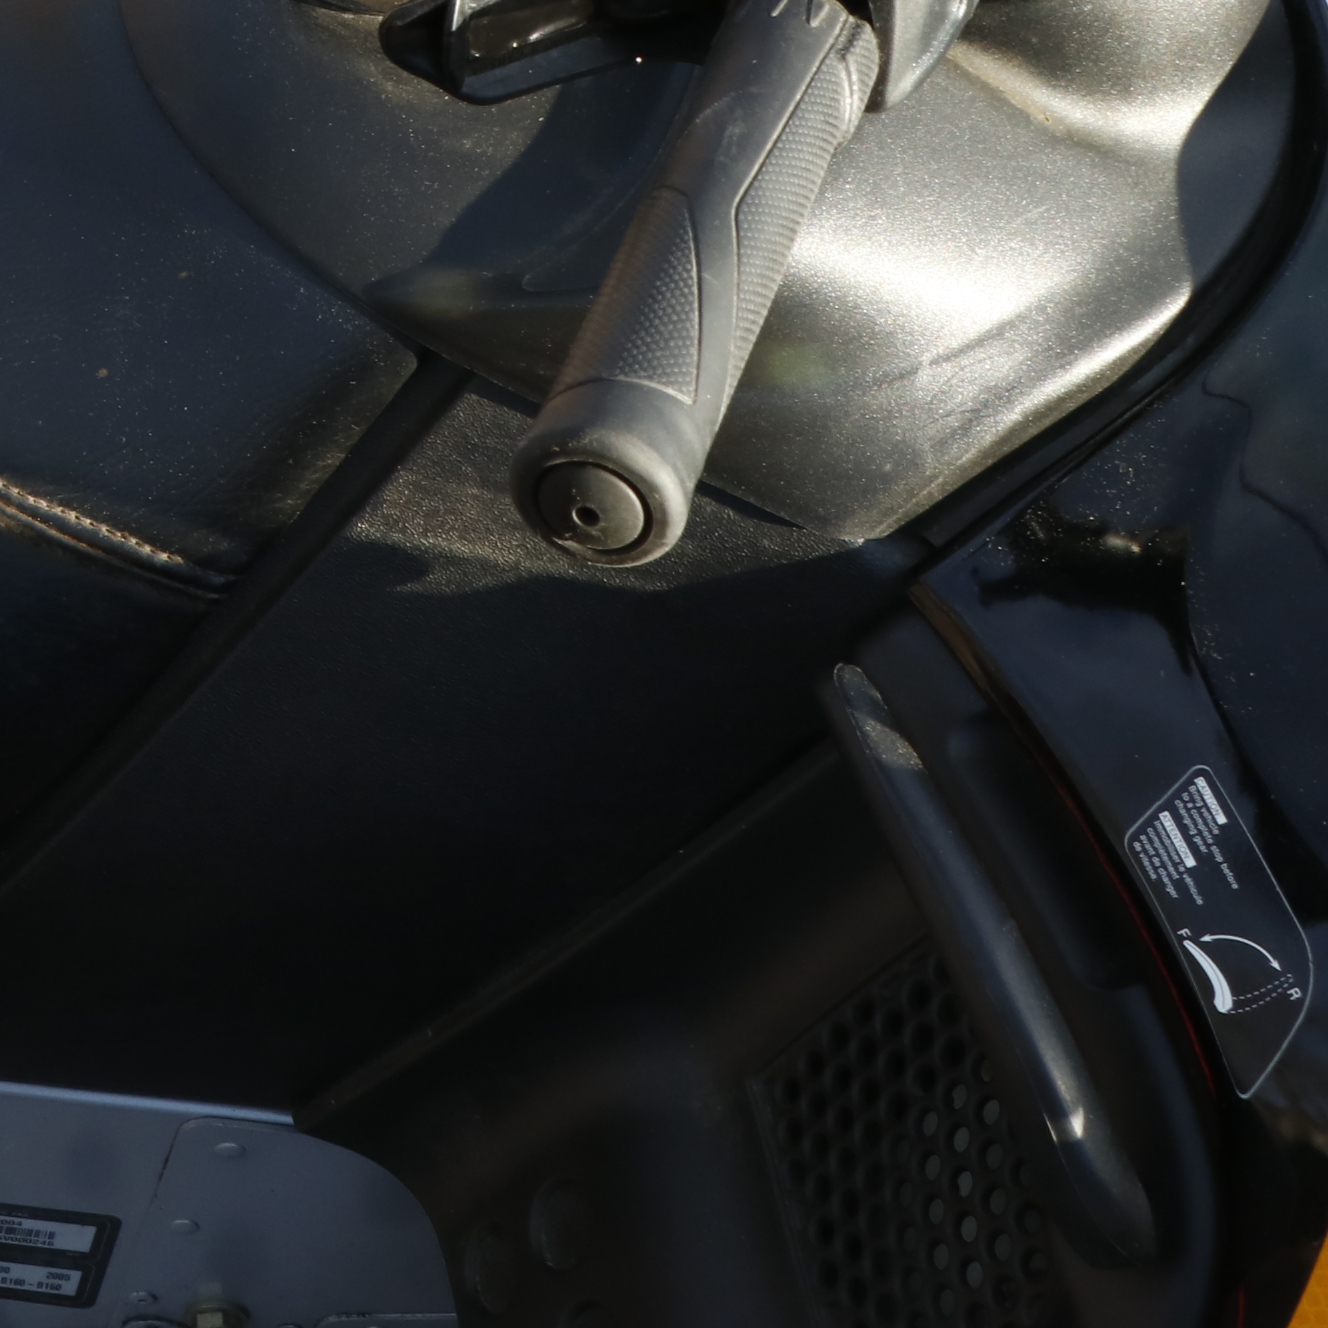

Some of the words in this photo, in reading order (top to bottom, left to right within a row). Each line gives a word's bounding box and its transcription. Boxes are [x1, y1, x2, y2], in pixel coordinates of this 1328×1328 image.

[1174, 799, 1198, 835] changing
[1188, 784, 1204, 807] Bring
[1200, 807, 1219, 835] vehicle
[1133, 841, 1143, 852] de
[1181, 792, 1190, 801] to
[1190, 809, 1214, 844] complete
[1210, 845, 1224, 863] stop
[1220, 863, 1239, 889] before
[1139, 834, 1156, 856] avant
[1151, 856, 1161, 867] de
[1157, 867, 1179, 898] changer
[1177, 927, 1192, 938] F
[1287, 987, 1303, 1001] R
[45, 1271, 72, 1281] 2005
